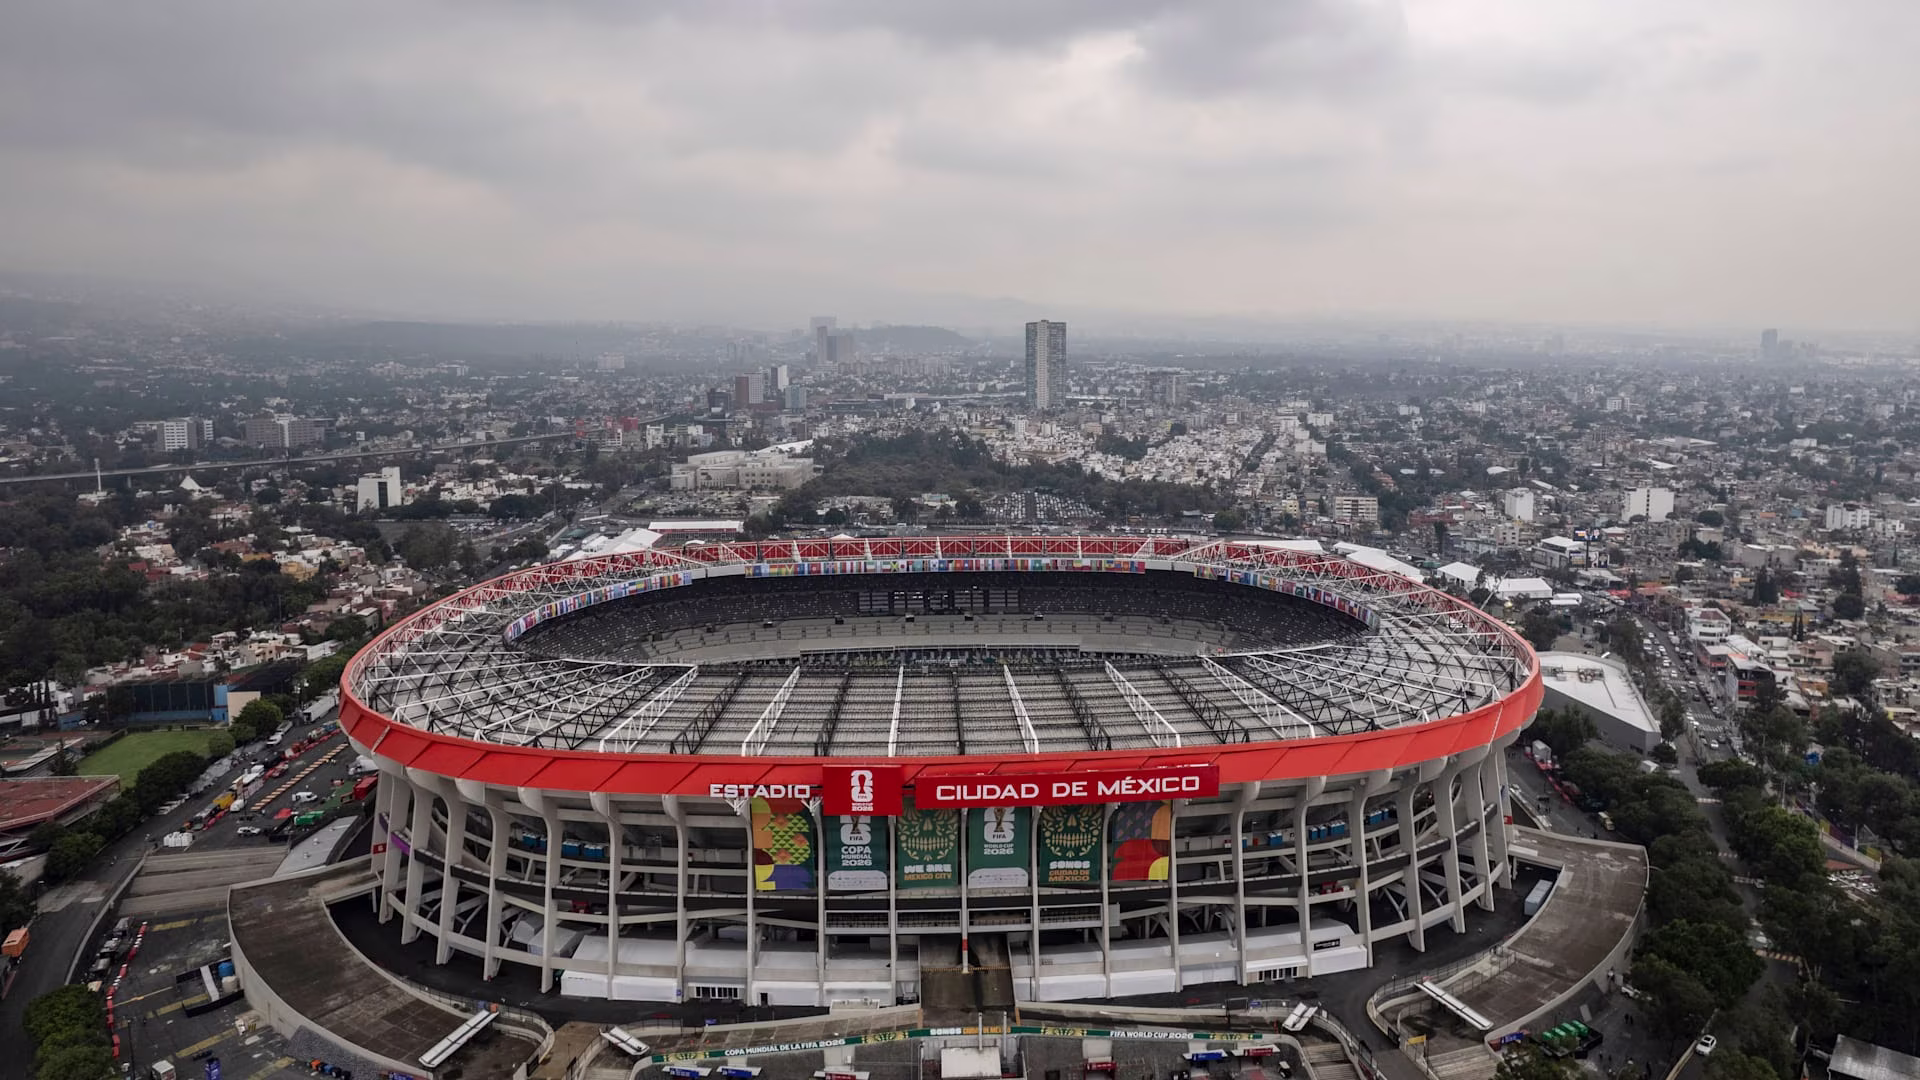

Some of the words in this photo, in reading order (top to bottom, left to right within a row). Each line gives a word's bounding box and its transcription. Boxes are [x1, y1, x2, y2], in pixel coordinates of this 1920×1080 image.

[710, 784, 811, 798] ESTADIO
[936, 783, 1039, 800] CIUDAD
[1052, 782, 1088, 798] DE
[1097, 776, 1200, 796] MÉXICO
[841, 845, 872, 854] COPA
[904, 865, 924, 873] WE
[1049, 861, 1090, 869] SOMOS
[746, 1046, 779, 1054] MUNDIAL
[819, 1039, 846, 1047] 2026
